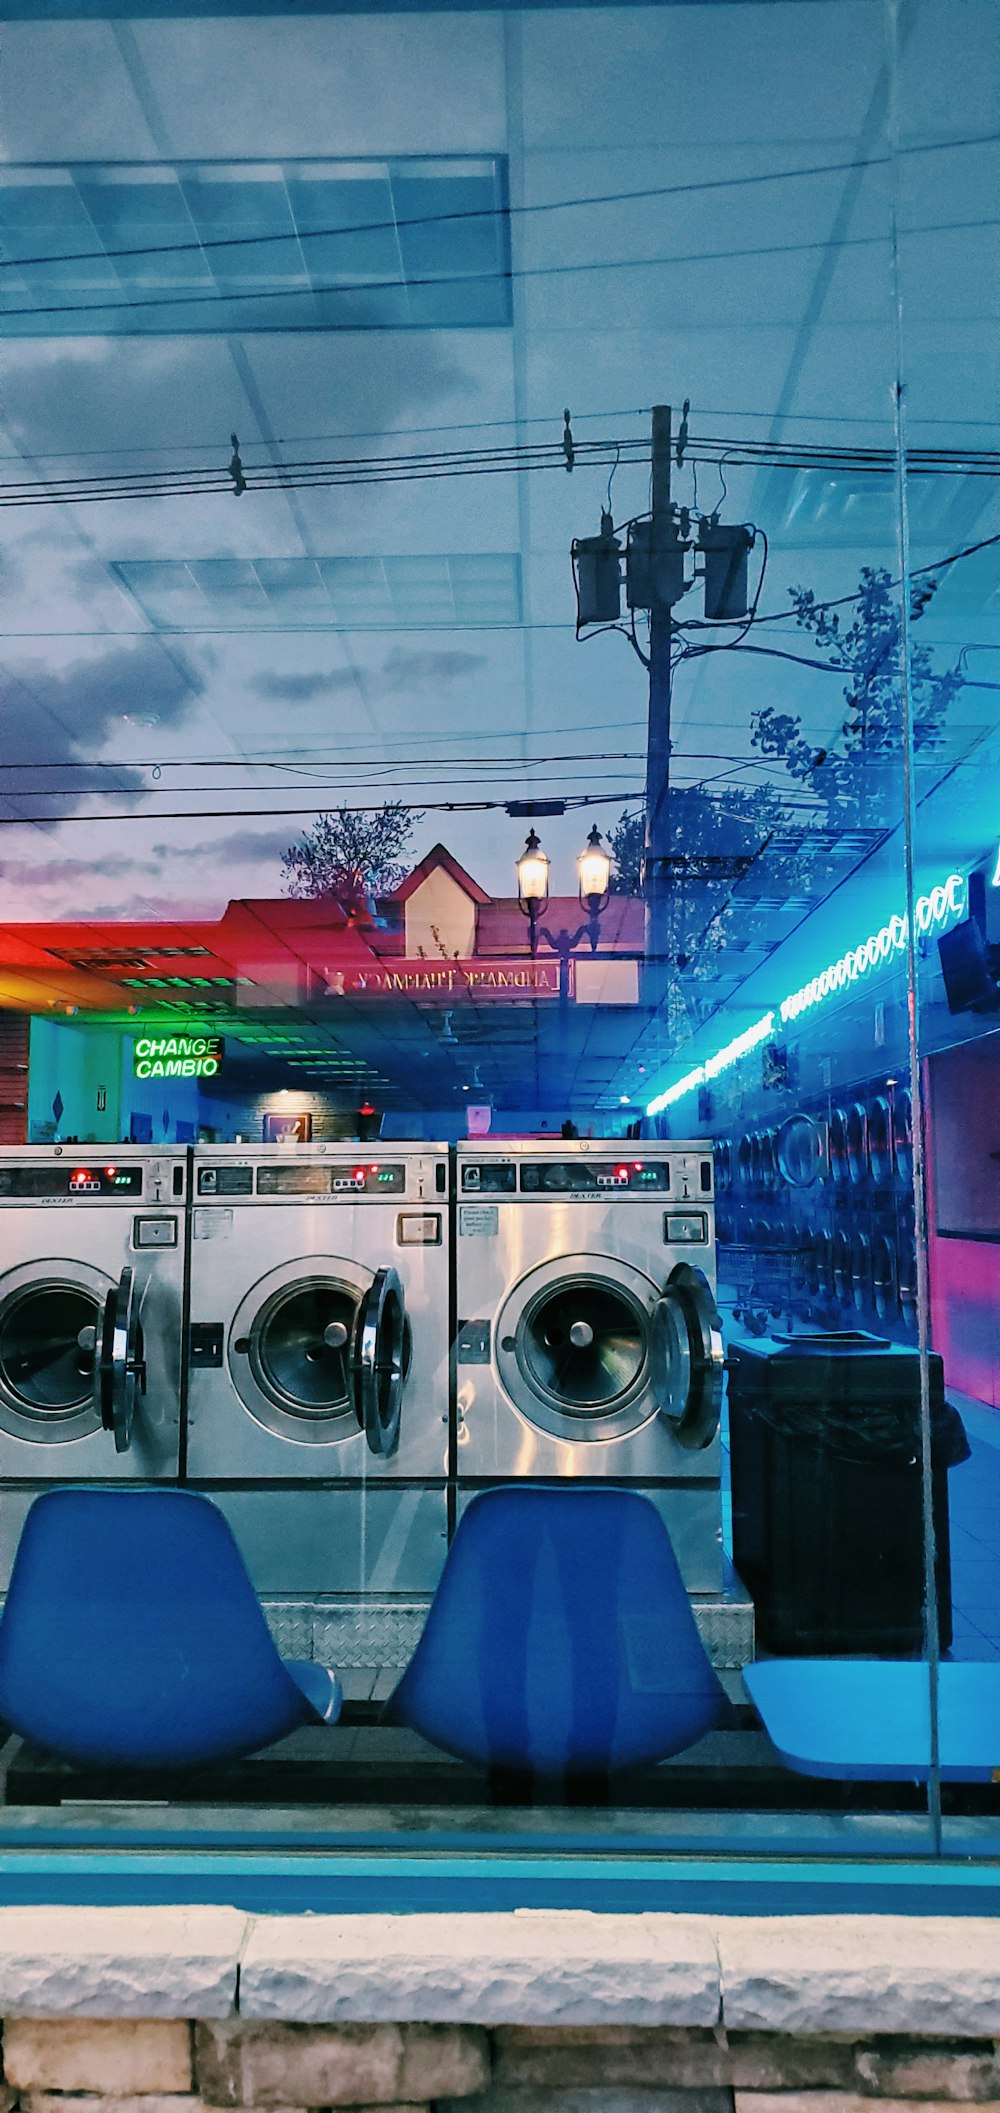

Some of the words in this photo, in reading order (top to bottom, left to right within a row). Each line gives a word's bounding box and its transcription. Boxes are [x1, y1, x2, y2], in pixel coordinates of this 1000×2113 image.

[135, 1038, 220, 1057] CHANGE
[136, 1058, 218, 1079] CAMBIO
[569, 1192, 601, 1200] DEXTER
